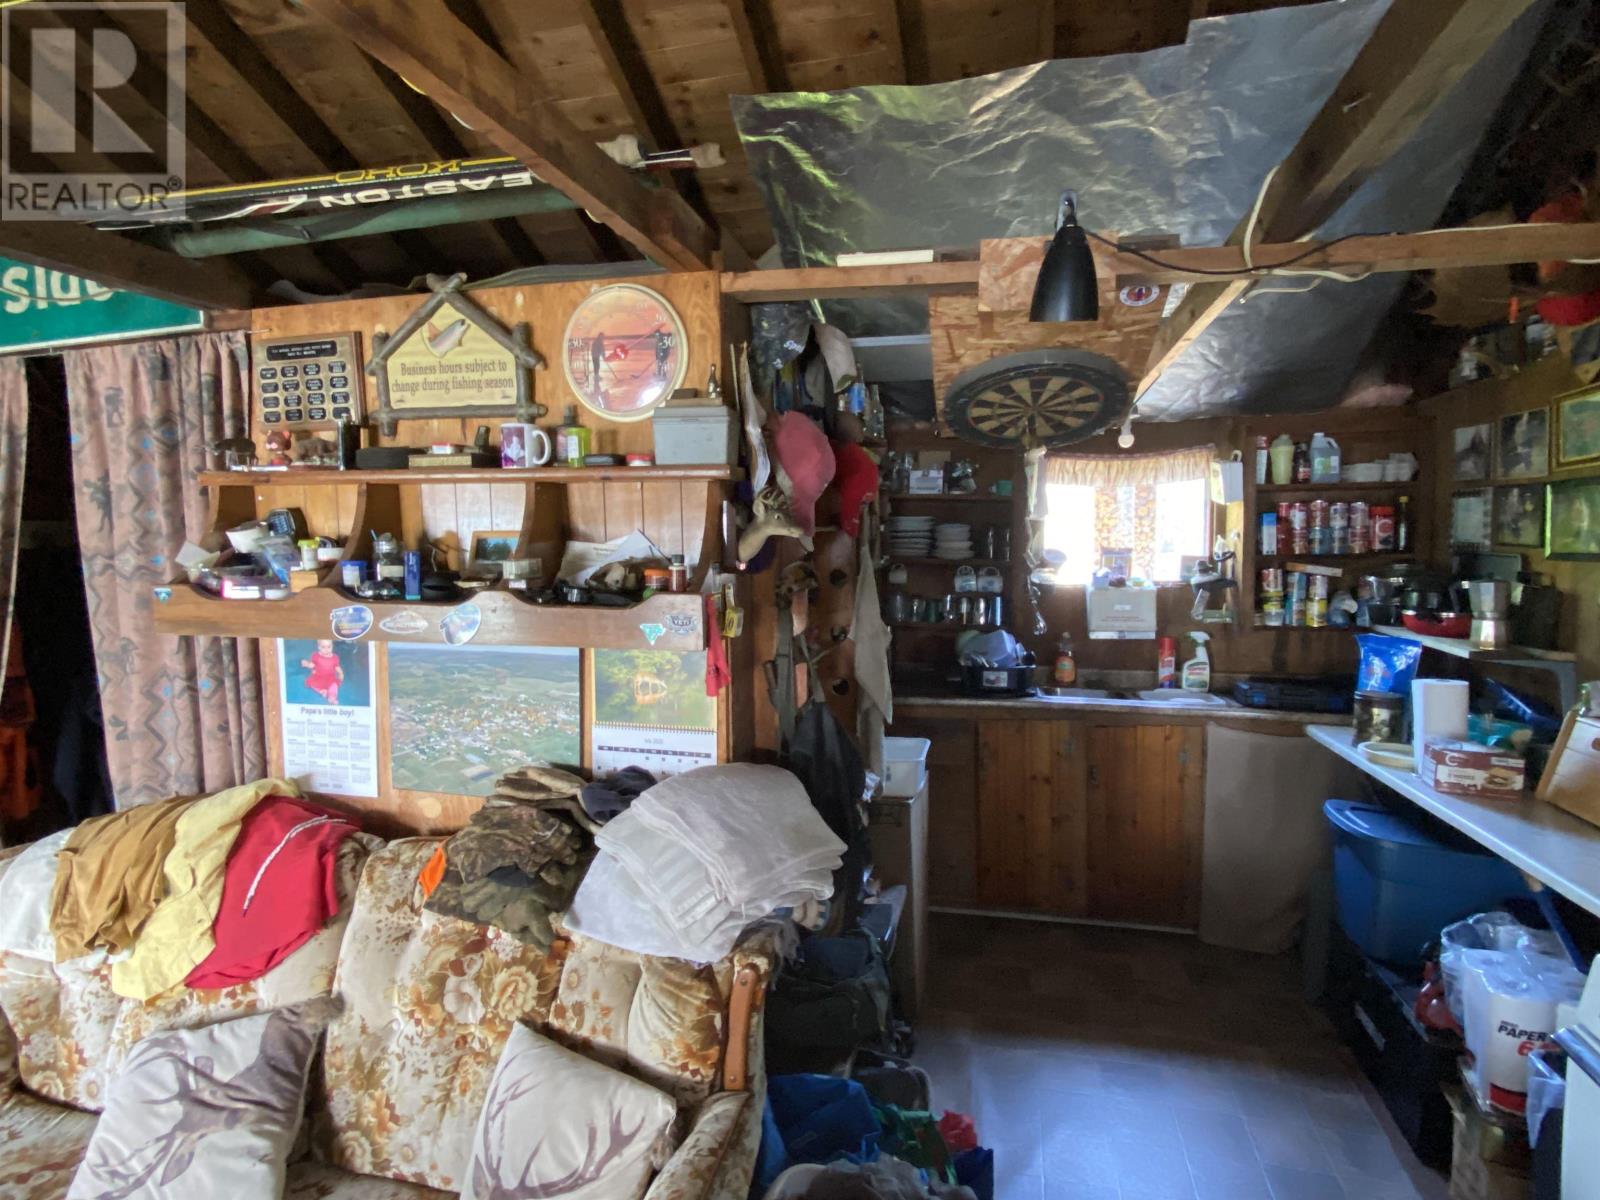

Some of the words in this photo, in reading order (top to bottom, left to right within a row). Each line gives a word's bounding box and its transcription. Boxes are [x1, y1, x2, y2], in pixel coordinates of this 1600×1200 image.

[336, 160, 463, 184] KOHO
[320, 171, 533, 208] EASTON
[401, 362, 437, 376] Business
[439, 361, 462, 374] hours
[465, 359, 496, 376] subject
[498, 359, 508, 372] to
[392, 379, 420, 396] change
[422, 377, 450, 394] during
[452, 376, 482, 393] fishing
[484, 377, 514, 388] season
[1498, 1025, 1548, 1042] PAPER
